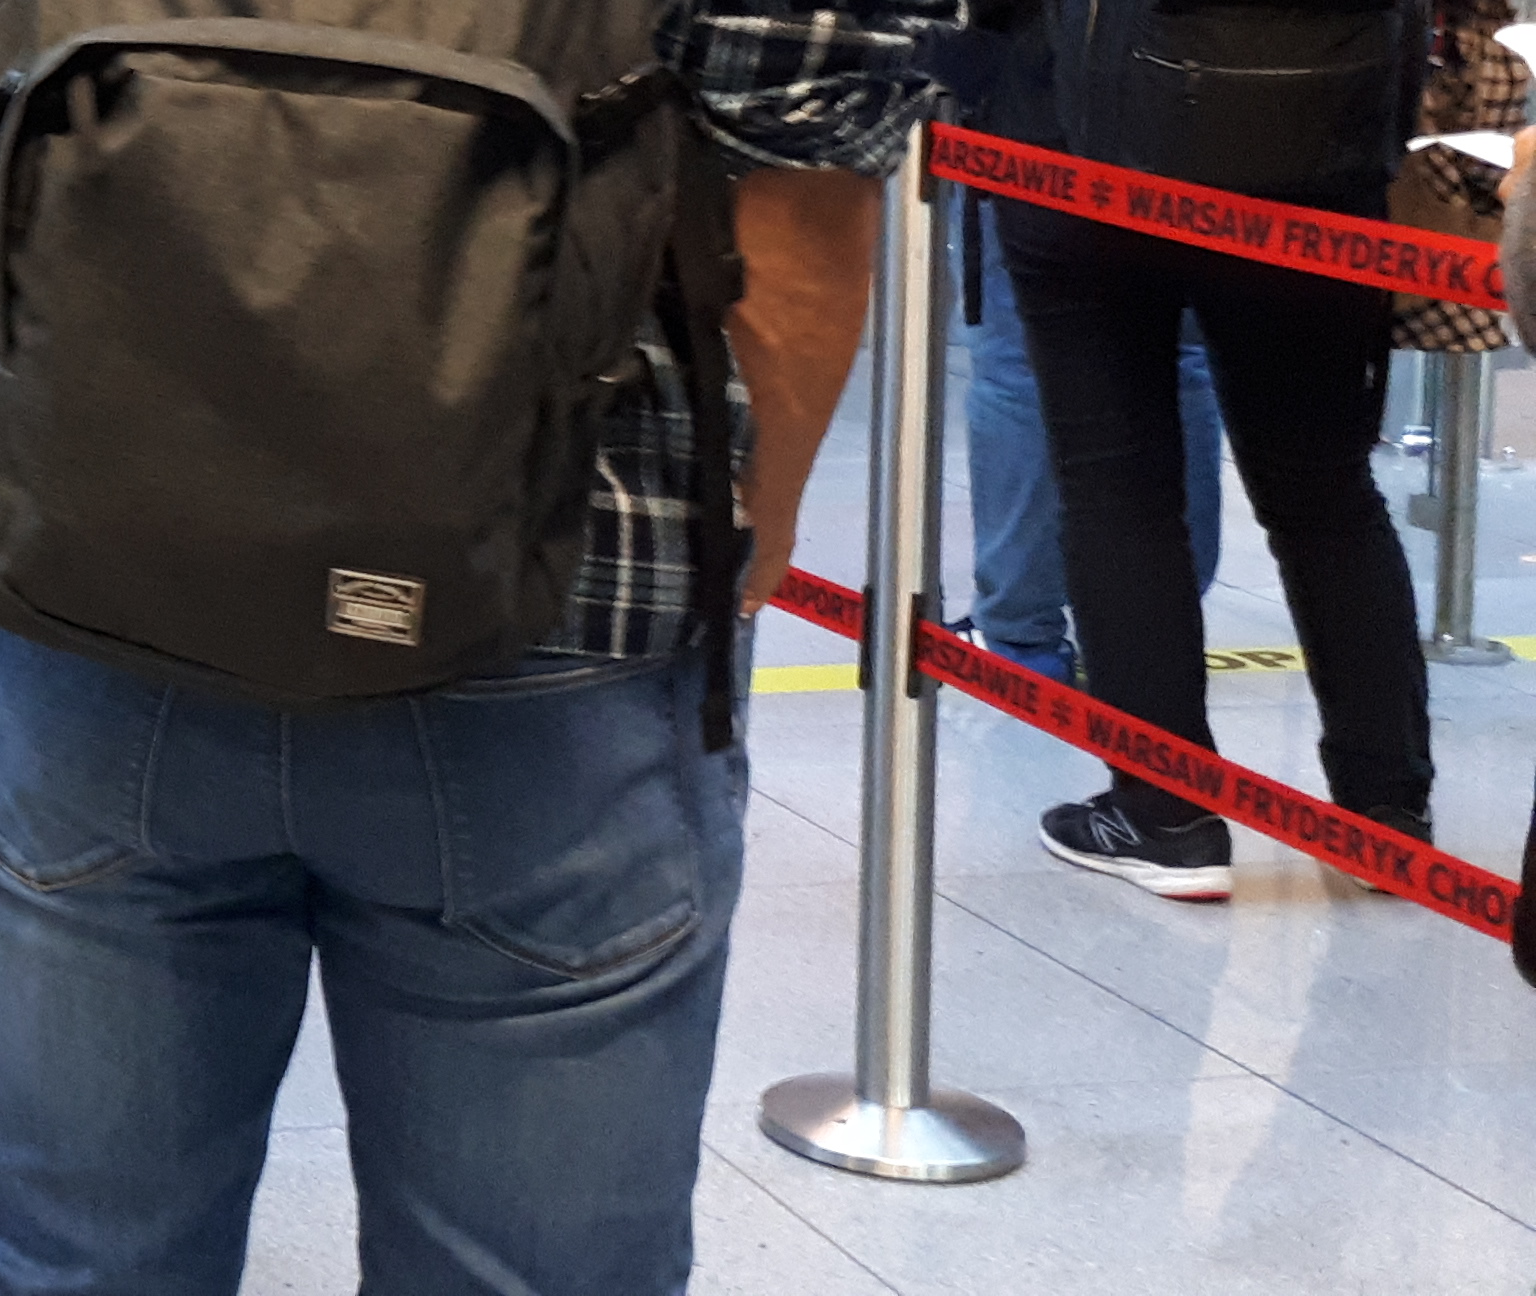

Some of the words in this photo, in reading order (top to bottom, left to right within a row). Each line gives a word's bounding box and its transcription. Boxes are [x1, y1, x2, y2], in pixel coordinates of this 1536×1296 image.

[1128, 183, 1273, 248] WARSAW
[1282, 218, 1473, 292] FRYDERYK
[1085, 708, 1224, 801] WARSAW
[1233, 778, 1416, 887] FRYDERYK
